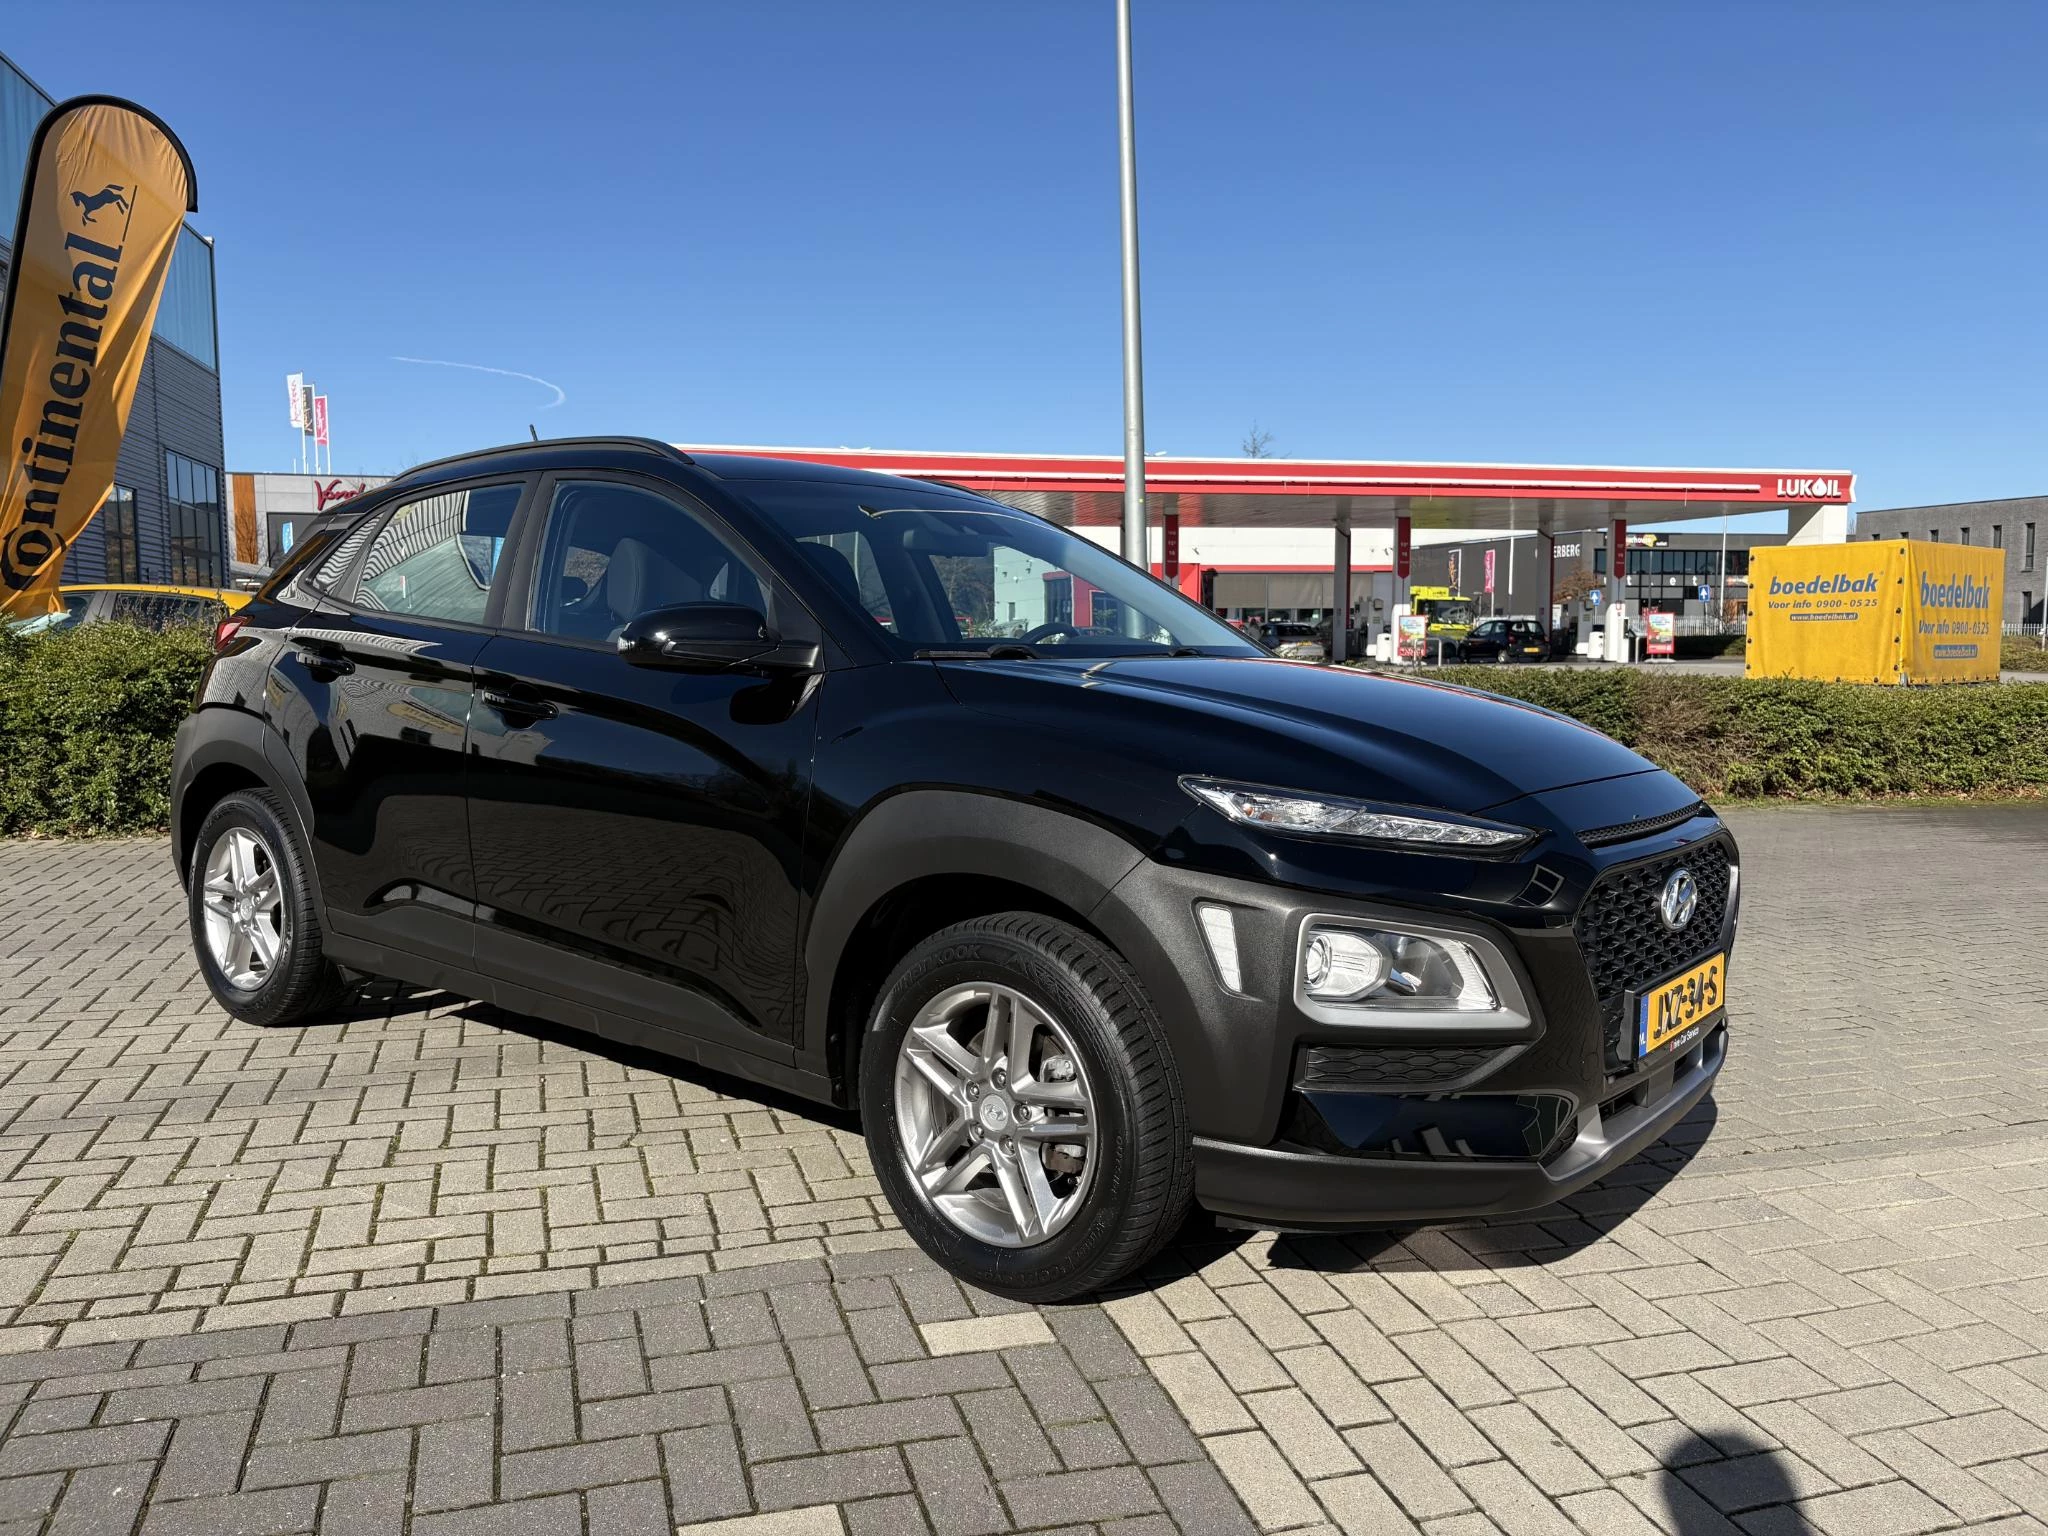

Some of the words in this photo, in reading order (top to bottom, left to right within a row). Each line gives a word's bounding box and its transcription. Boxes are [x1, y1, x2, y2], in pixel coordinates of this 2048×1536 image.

[1, 232, 123, 591] Continental
[1777, 477, 1842, 497] LUKOIL
[1769, 572, 1879, 595] boedelbak
[1921, 571, 1990, 608] boedelbak
[1768, 601, 1790, 609] Voor
[1793, 600, 1812, 609] info
[1919, 619, 1935, 634] Voor
[1654, 966, 1717, 1039] JXZ-34-S
